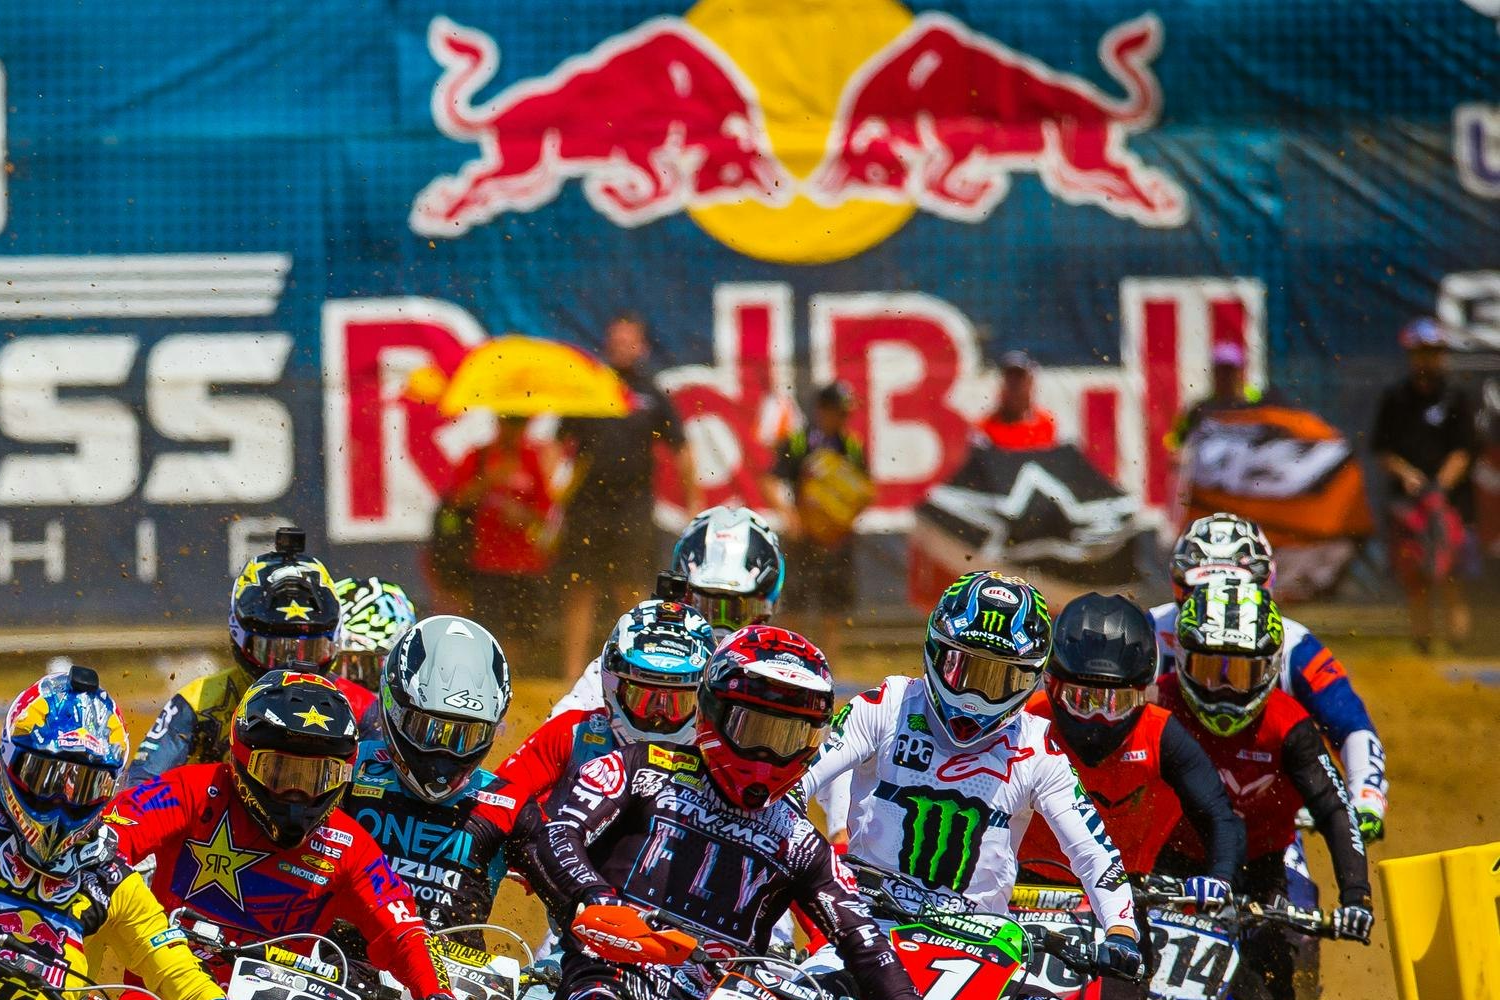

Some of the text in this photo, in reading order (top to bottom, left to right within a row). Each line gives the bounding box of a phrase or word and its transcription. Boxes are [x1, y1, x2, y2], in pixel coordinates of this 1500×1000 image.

[321, 277, 1265, 543] Rd Bl
[989, 589, 1013, 601] BELL
[959, 630, 1016, 650] MONSTER
[444, 690, 483, 711] 6D
[896, 736, 934, 764] PPG
[389, 857, 463, 891] UZUKI
[1099, 859, 1125, 888] MONS
[407, 881, 453, 907] YOTA
[932, 914, 998, 940] ENTHAL
[1018, 911, 1073, 923] LUCAS OIL
[573, 924, 643, 952] ACERBIS
[927, 934, 983, 958] LUCAS OIL
[442, 938, 491, 966] OTAPER
[308, 983, 327, 996] OIL
[468, 970, 488, 985] OIL
